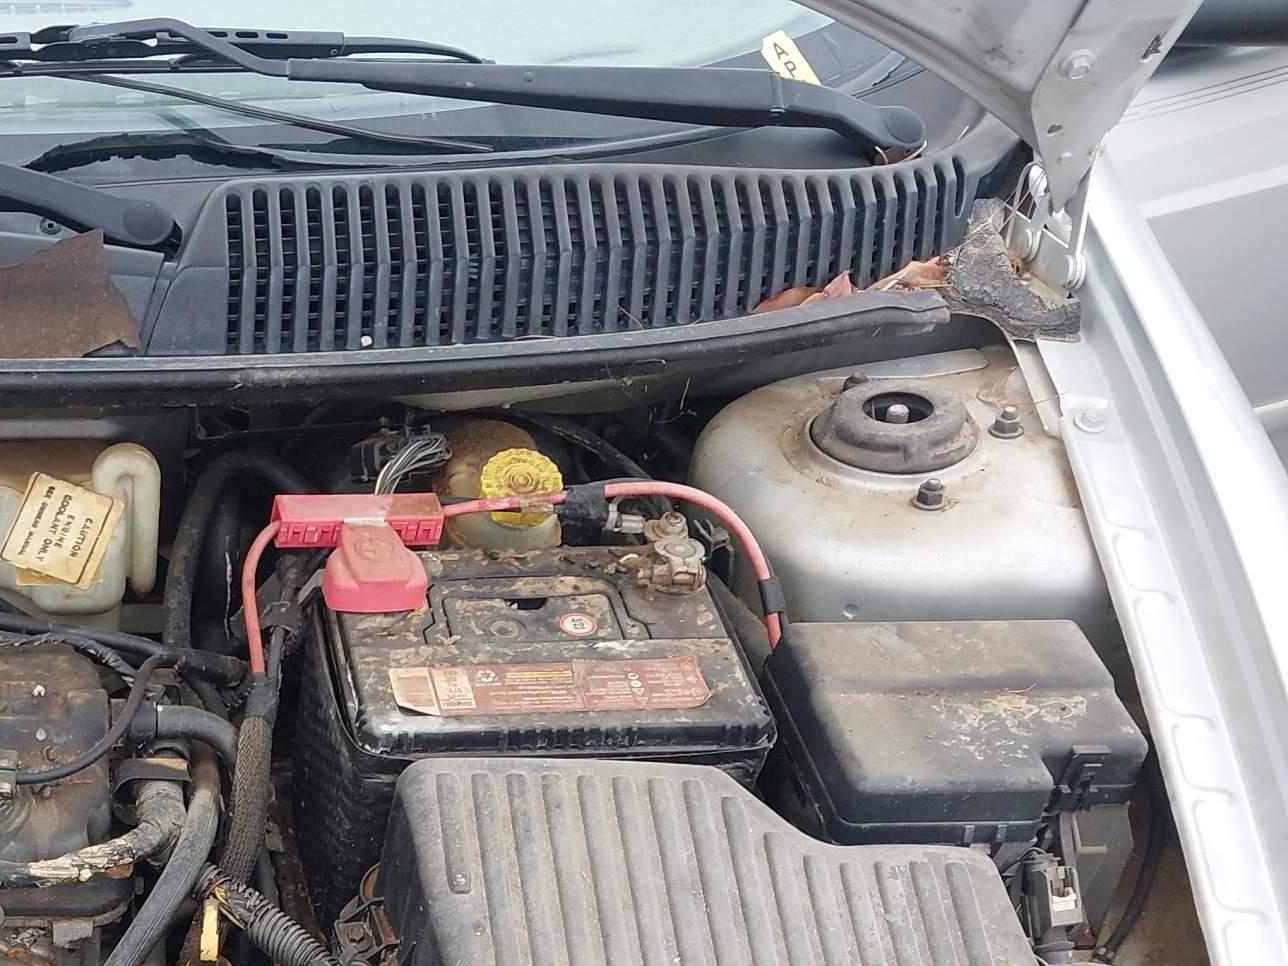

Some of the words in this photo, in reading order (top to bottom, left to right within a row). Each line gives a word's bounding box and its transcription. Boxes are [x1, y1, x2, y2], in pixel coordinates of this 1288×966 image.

[49, 494, 73, 535] COOLANT
[54, 514, 76, 548] ENGINE
[36, 538, 52, 562] ONLY
[70, 518, 94, 558] CAUTION
